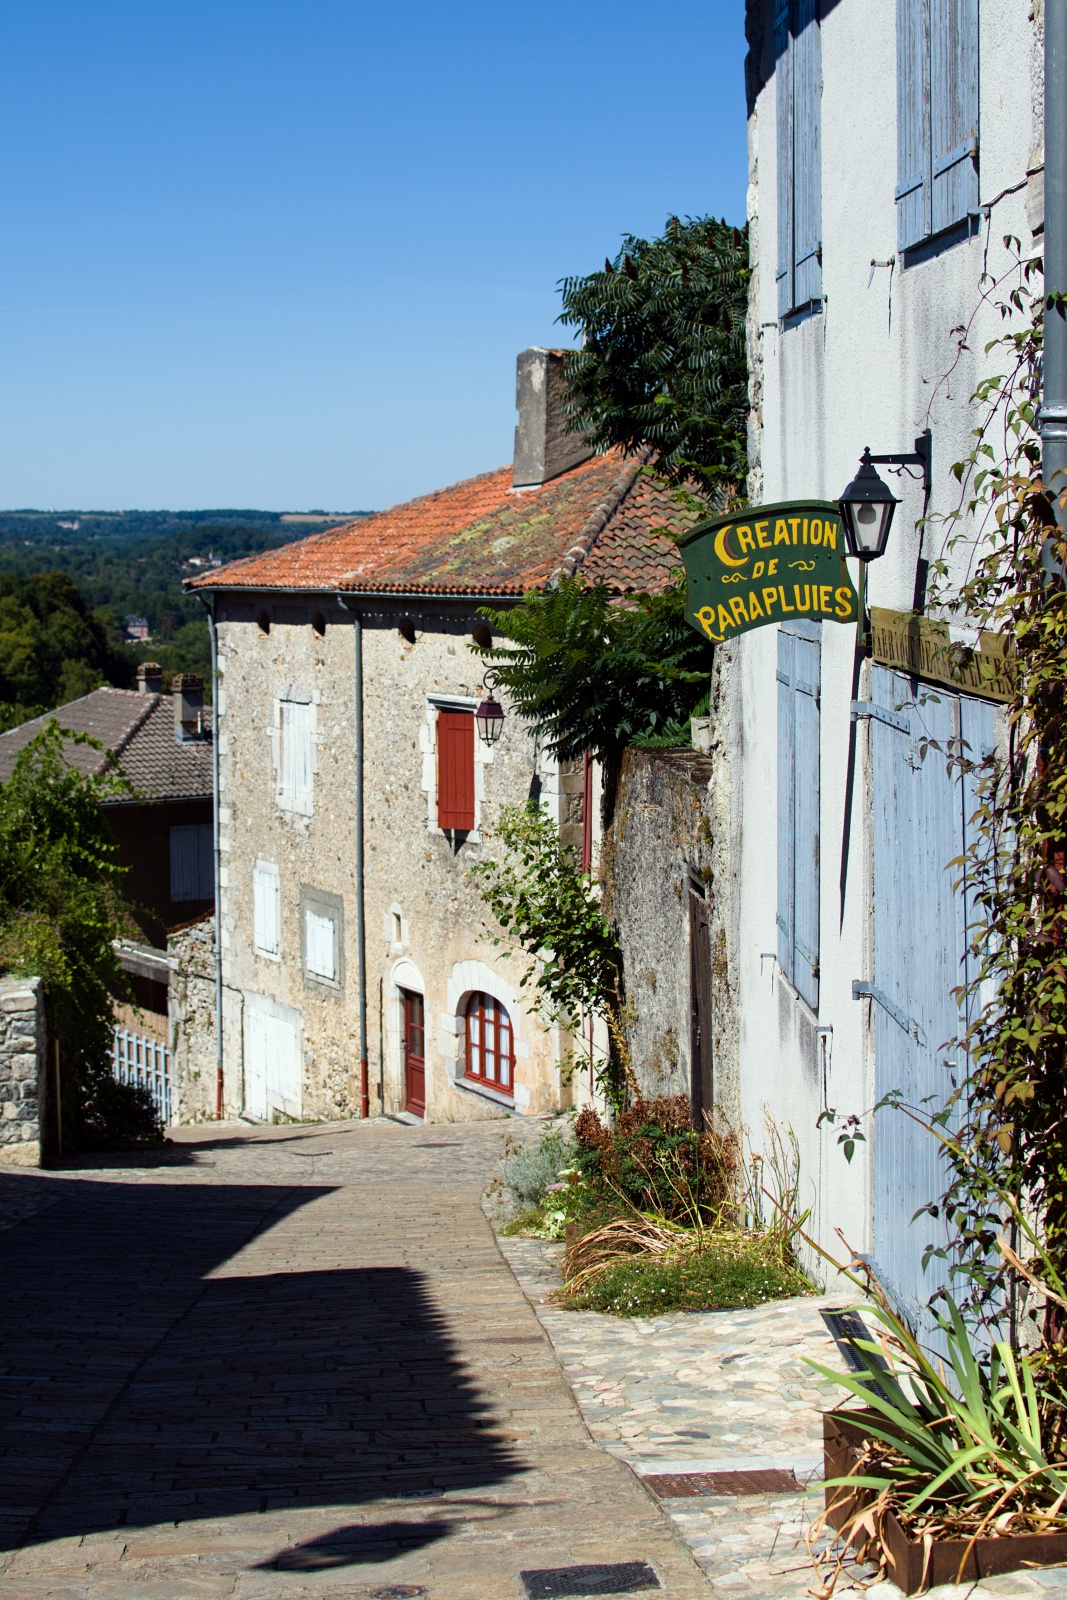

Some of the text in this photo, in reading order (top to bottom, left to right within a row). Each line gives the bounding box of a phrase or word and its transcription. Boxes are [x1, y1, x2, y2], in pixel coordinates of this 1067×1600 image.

[714, 519, 837, 567] CREATION
[752, 558, 779, 579] DE
[693, 584, 852, 641] PARAPLUIES
[872, 625, 916, 668] FABRIQUE
